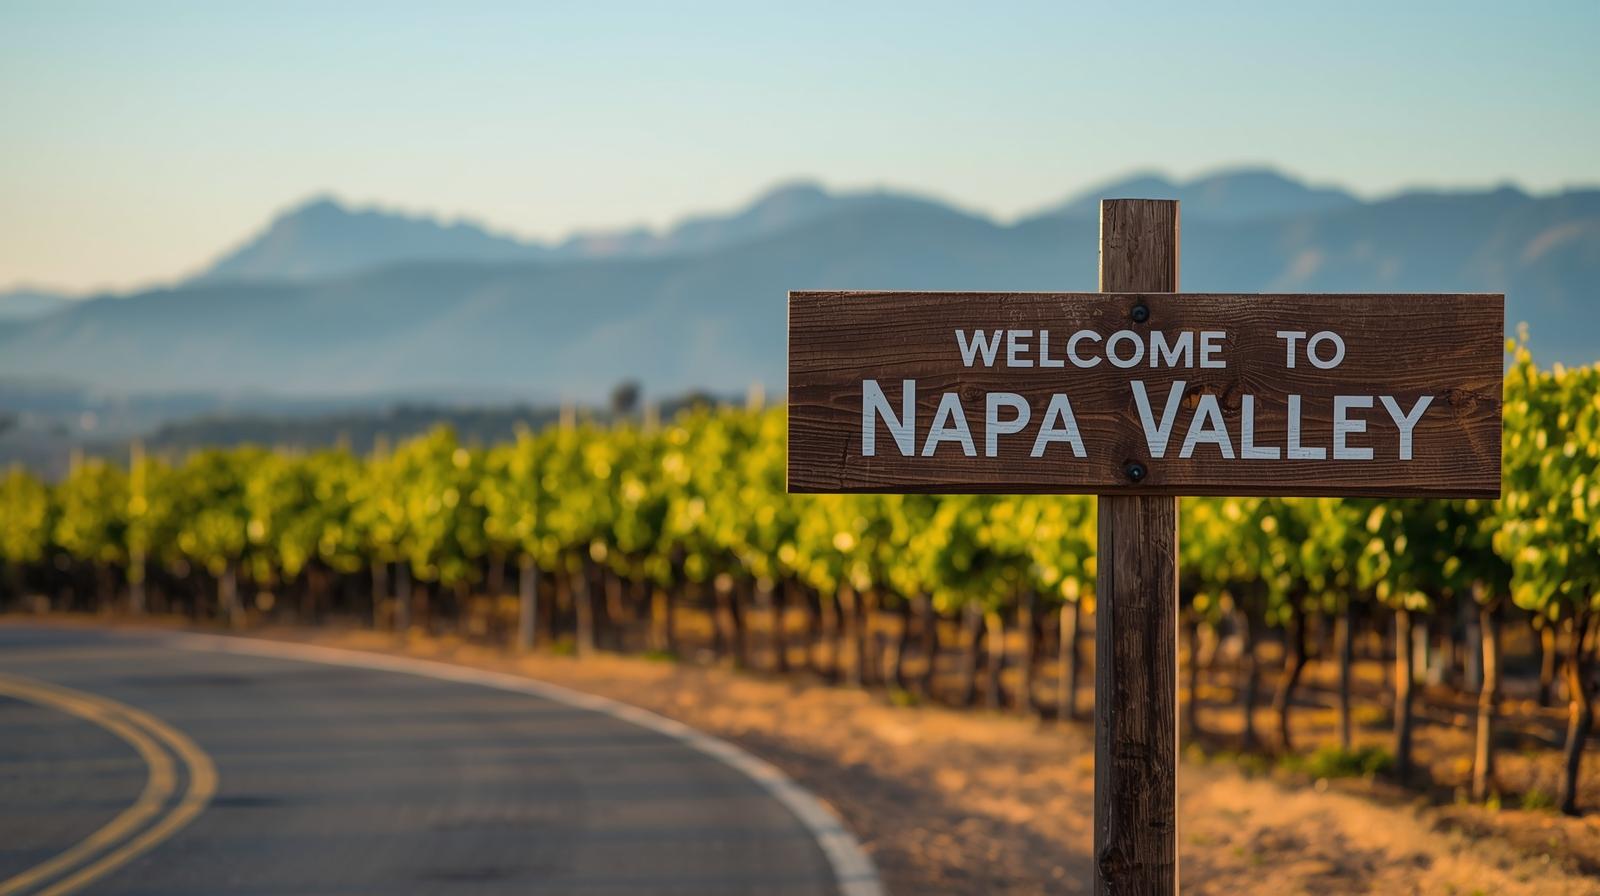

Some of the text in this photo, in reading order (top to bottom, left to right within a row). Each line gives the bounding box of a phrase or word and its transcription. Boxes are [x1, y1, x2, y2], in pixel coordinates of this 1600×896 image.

[955, 329, 1346, 369] WELCOME TO
[861, 379, 1434, 460] NAPA VALLEY
